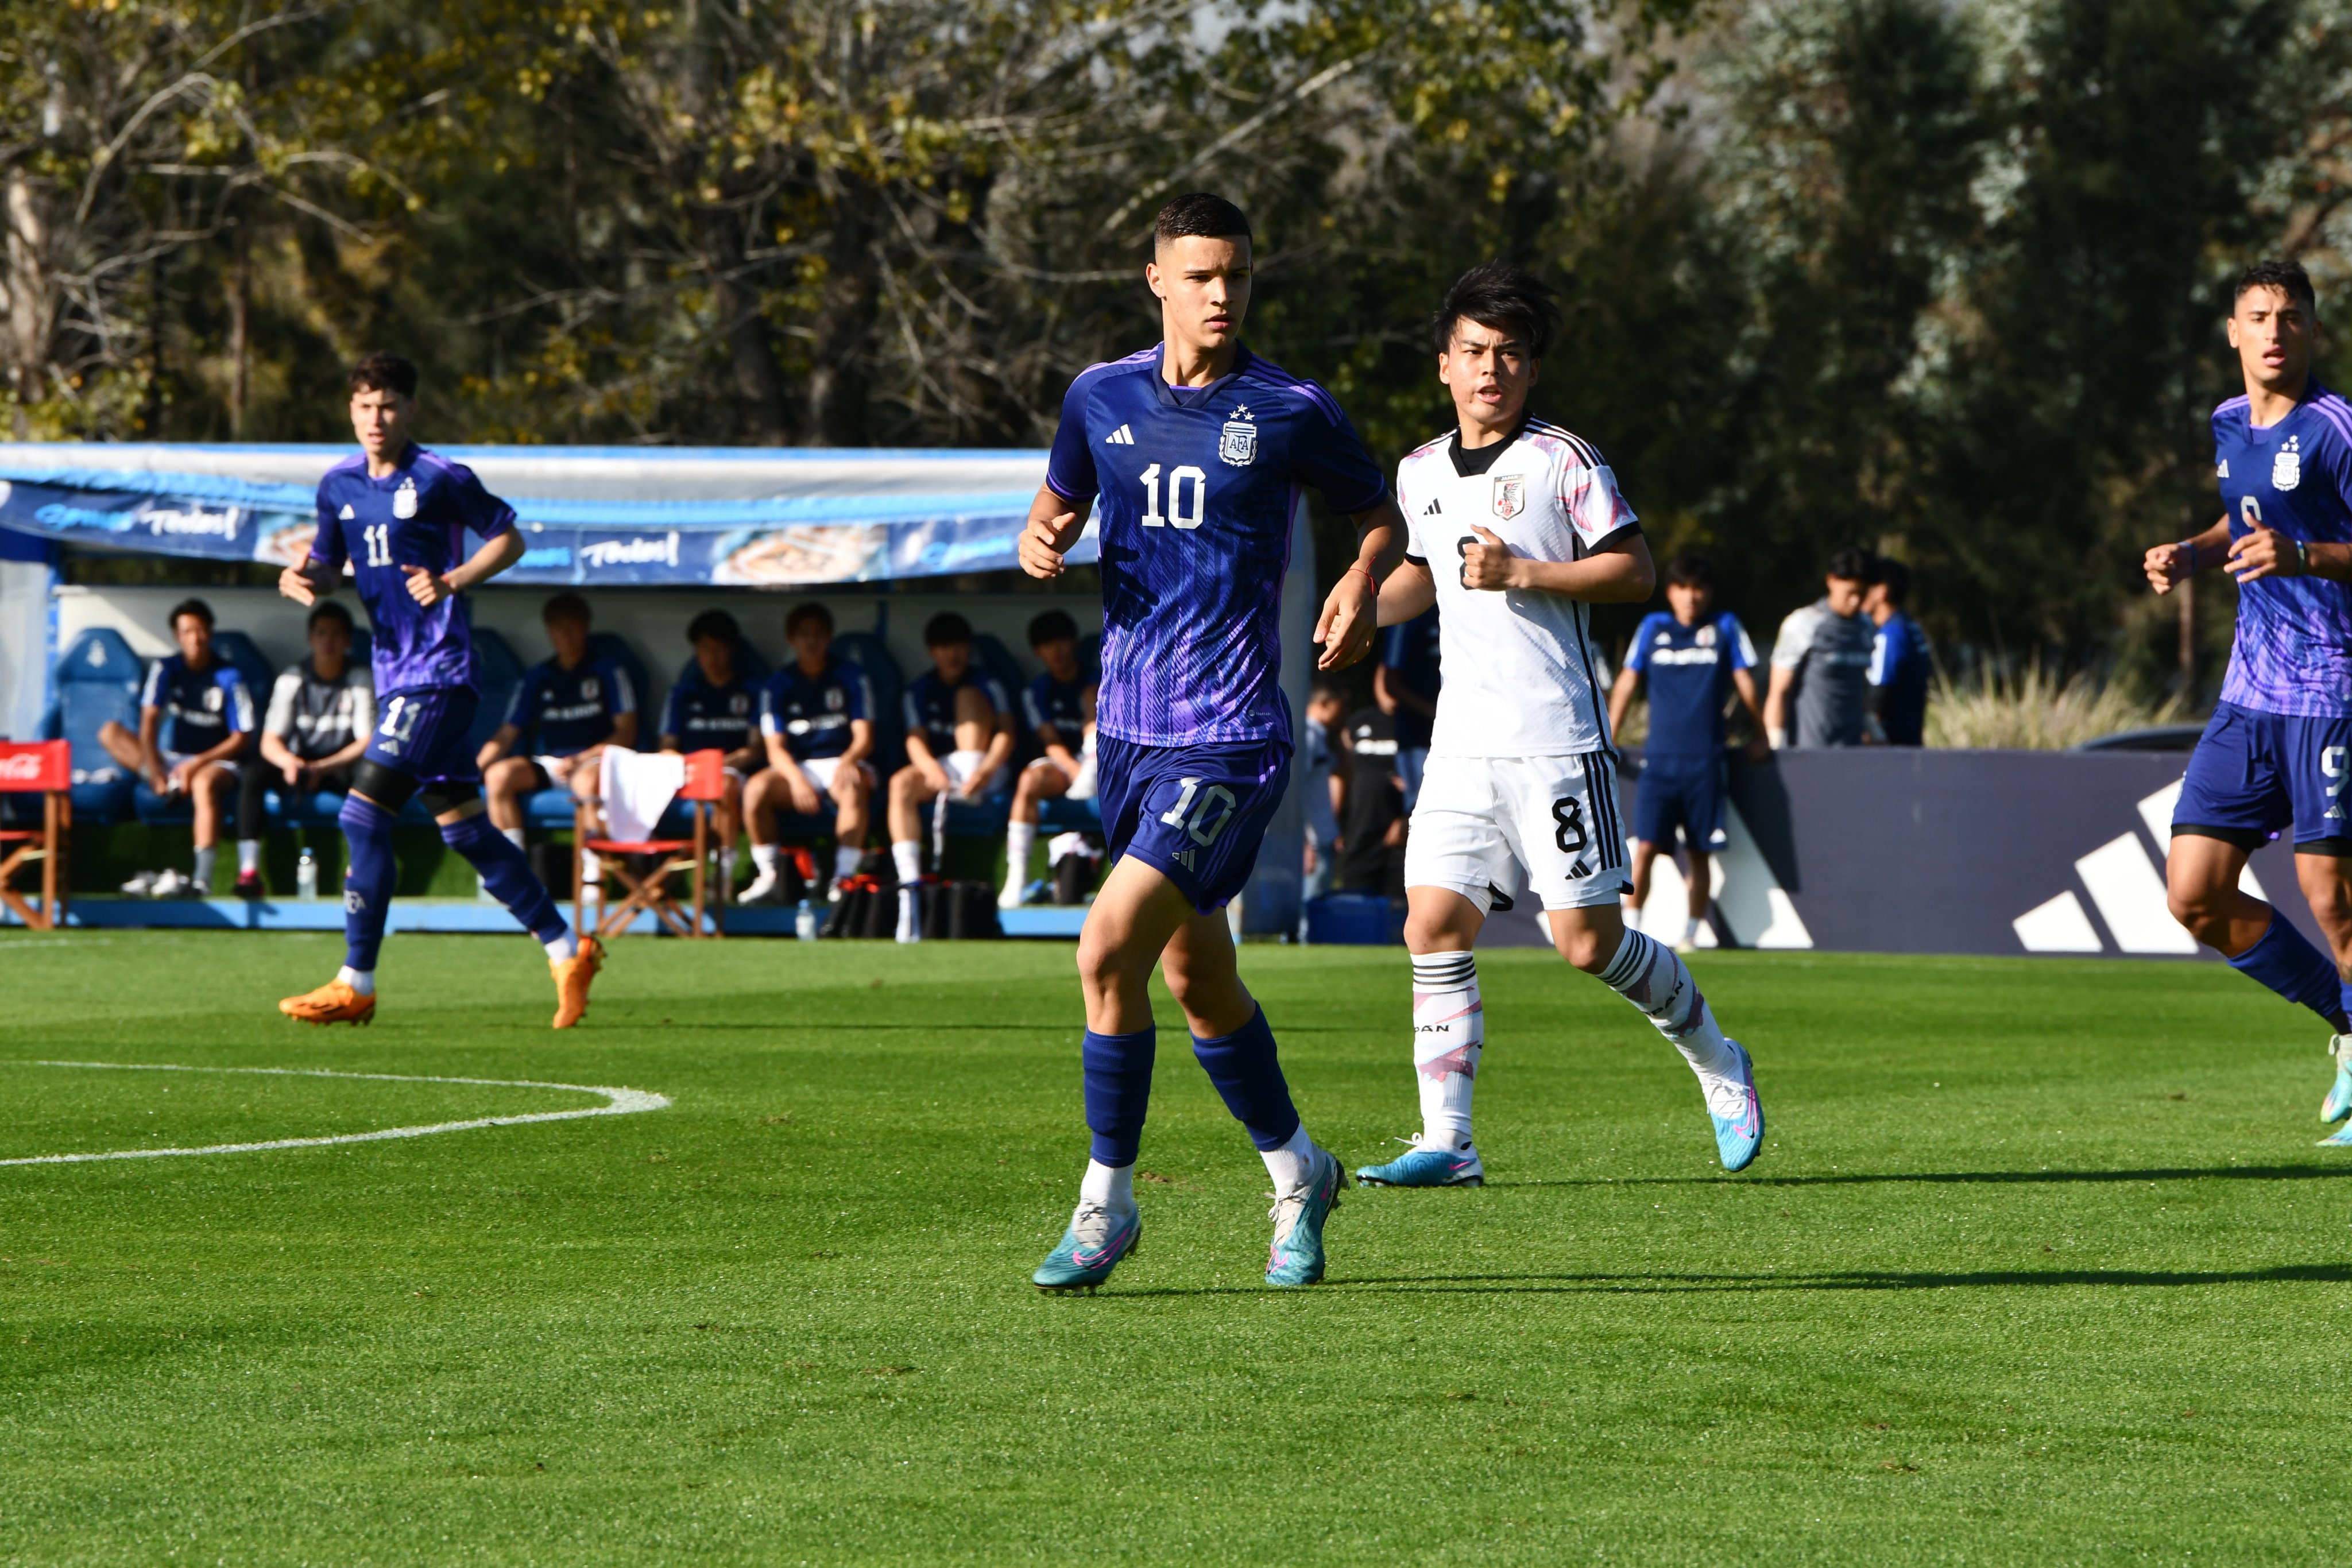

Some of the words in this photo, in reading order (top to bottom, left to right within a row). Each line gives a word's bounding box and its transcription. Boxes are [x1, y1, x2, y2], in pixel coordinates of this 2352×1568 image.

[1229, 433, 1249, 453] AFA
[1139, 463, 1206, 529] 10
[1500, 505, 1515, 513] JFA
[363, 523, 394, 567] 11
[379, 696, 421, 742] 11
[2322, 746, 2350, 797] 9
[1160, 776, 1236, 847] 10
[1552, 796, 1588, 853] 8
[1646, 979, 1684, 1017] PAN
